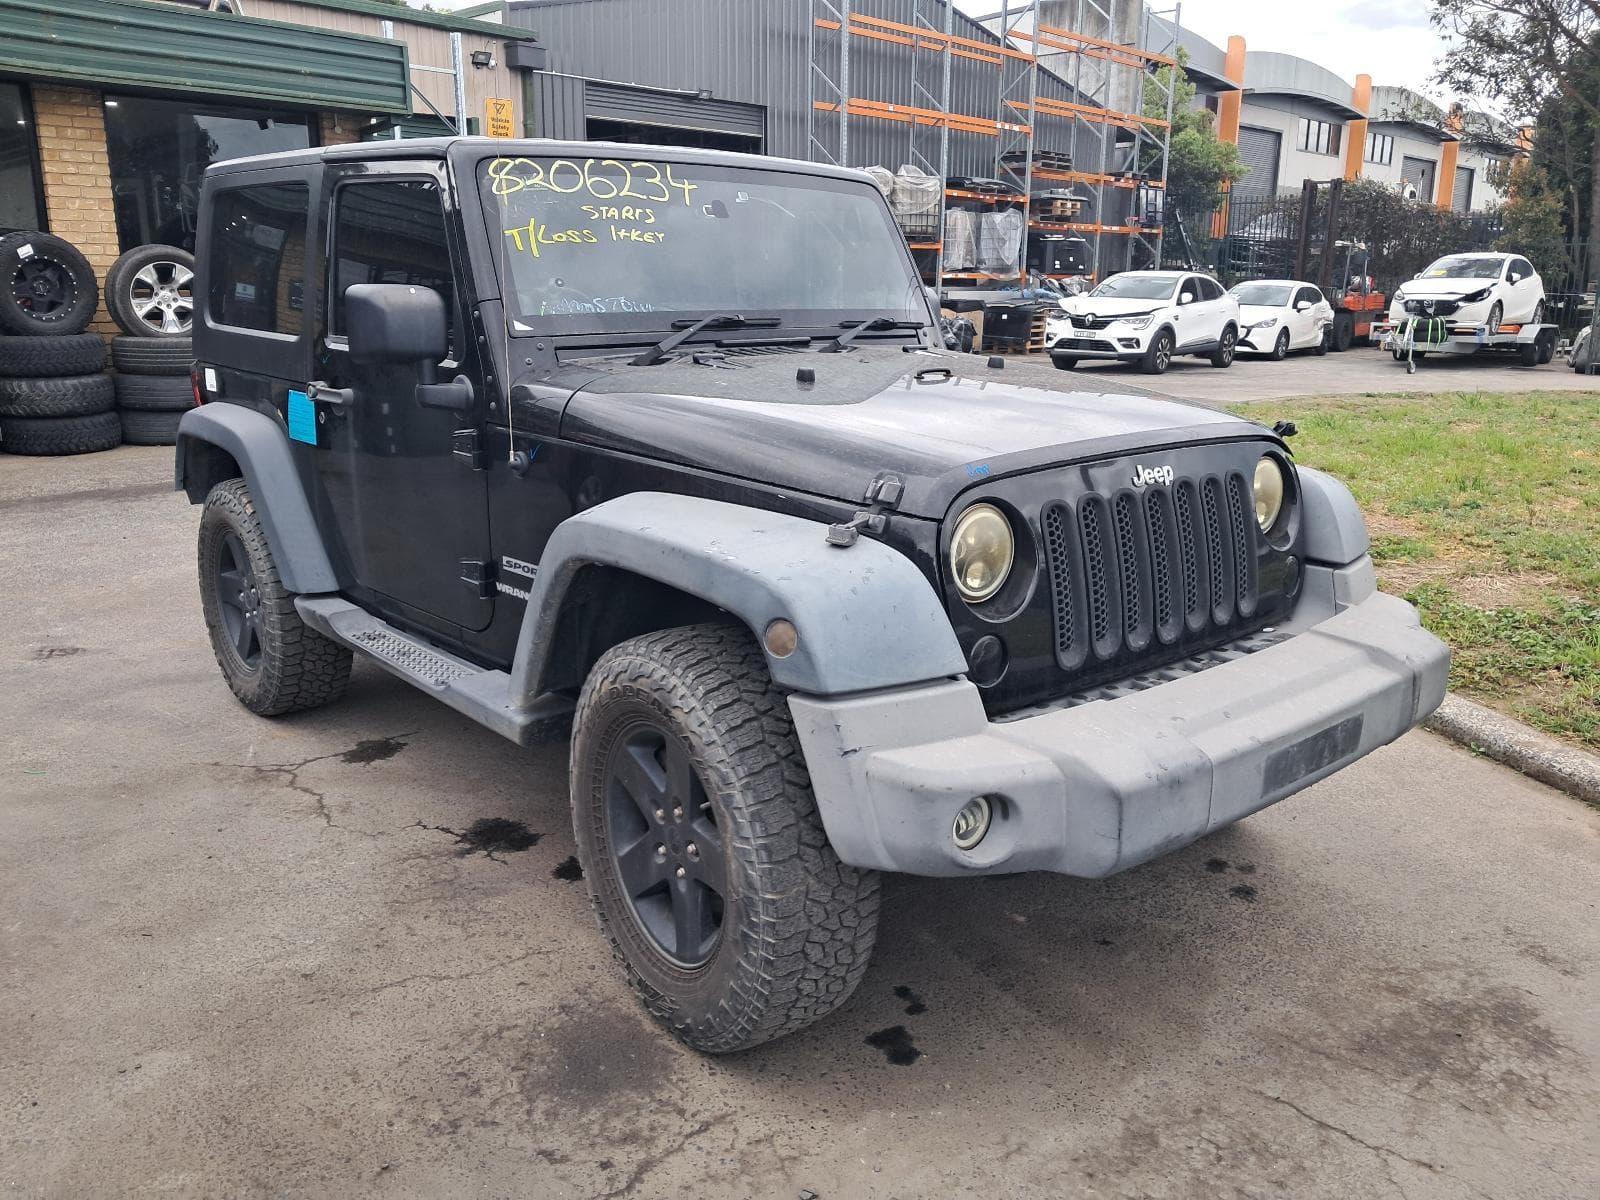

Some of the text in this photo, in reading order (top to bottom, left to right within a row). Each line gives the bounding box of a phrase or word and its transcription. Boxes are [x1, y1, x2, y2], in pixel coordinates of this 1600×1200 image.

[488, 158, 698, 206] 8206234
[580, 204, 656, 224] STARTS
[1131, 464, 1174, 488] Jeep
